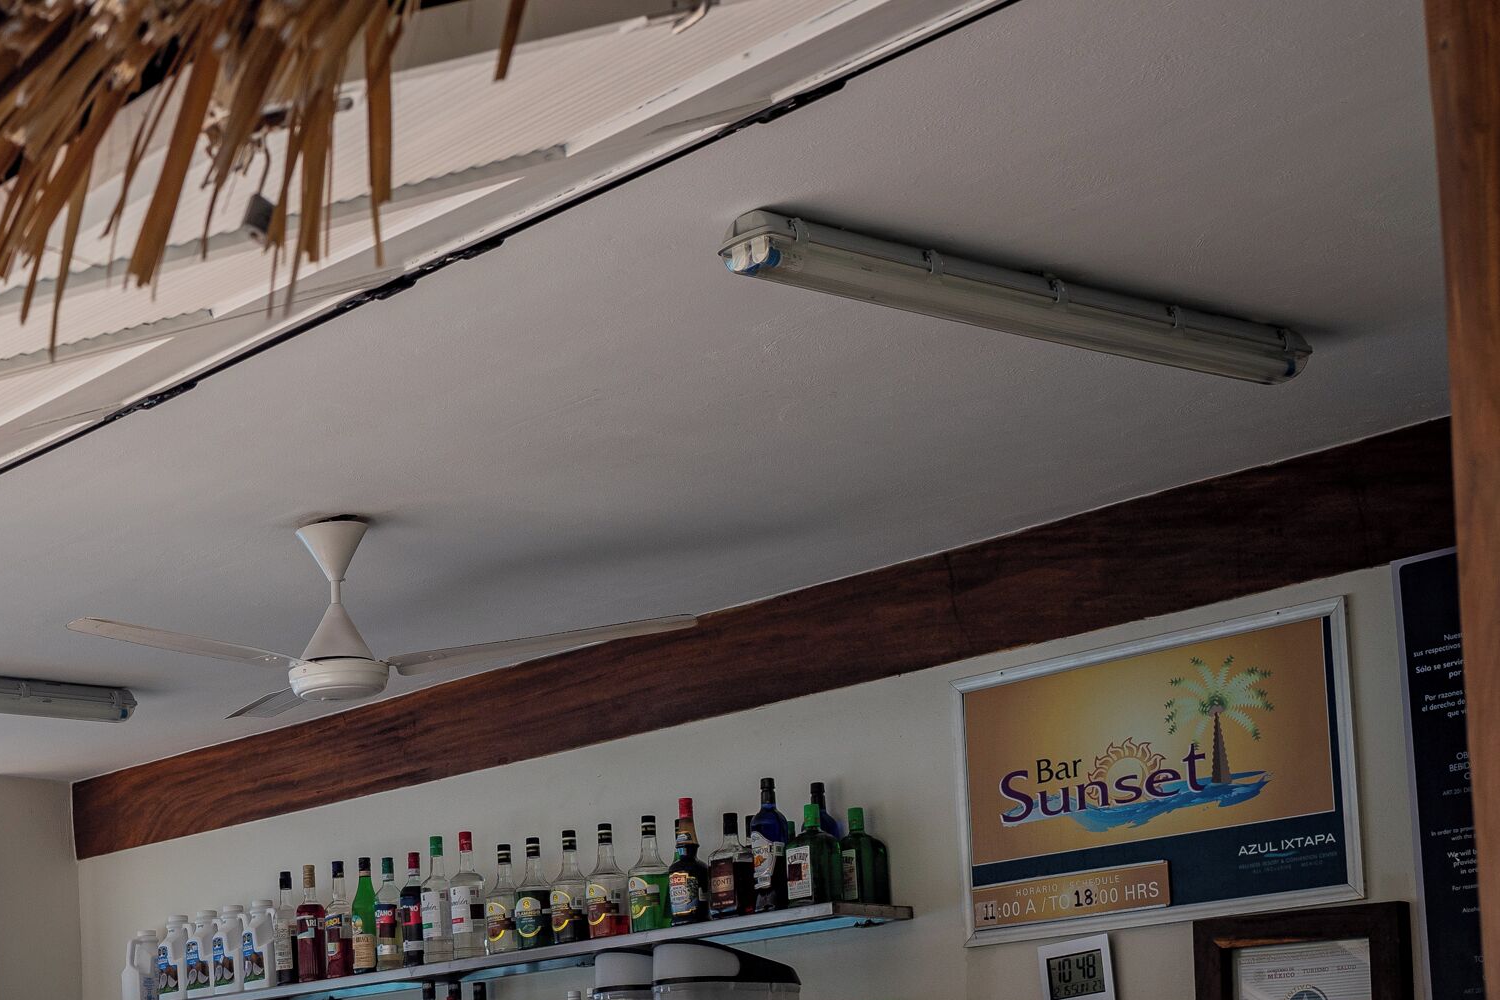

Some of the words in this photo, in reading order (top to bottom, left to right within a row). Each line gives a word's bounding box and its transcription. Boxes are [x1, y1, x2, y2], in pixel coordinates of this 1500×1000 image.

[1448, 670, 1462, 679] por
[1422, 704, 1428, 712] el
[1429, 700, 1456, 710] derecho
[1424, 694, 1436, 702] Por
[1447, 710, 1460, 718] que
[1036, 757, 1082, 784] Bar
[1000, 742, 1206, 823] Sunset
[1238, 840, 1278, 857] AZUL
[1280, 832, 1337, 852] IXTAPA
[1014, 883, 1058, 897] HORARIO
[1069, 874, 1120, 888] SCHEDULE
[982, 900, 1020, 921] 11:00
[1025, 900, 1037, 914] A
[1074, 888, 1118, 907] 18:00
[1124, 882, 1159, 902] HRS
